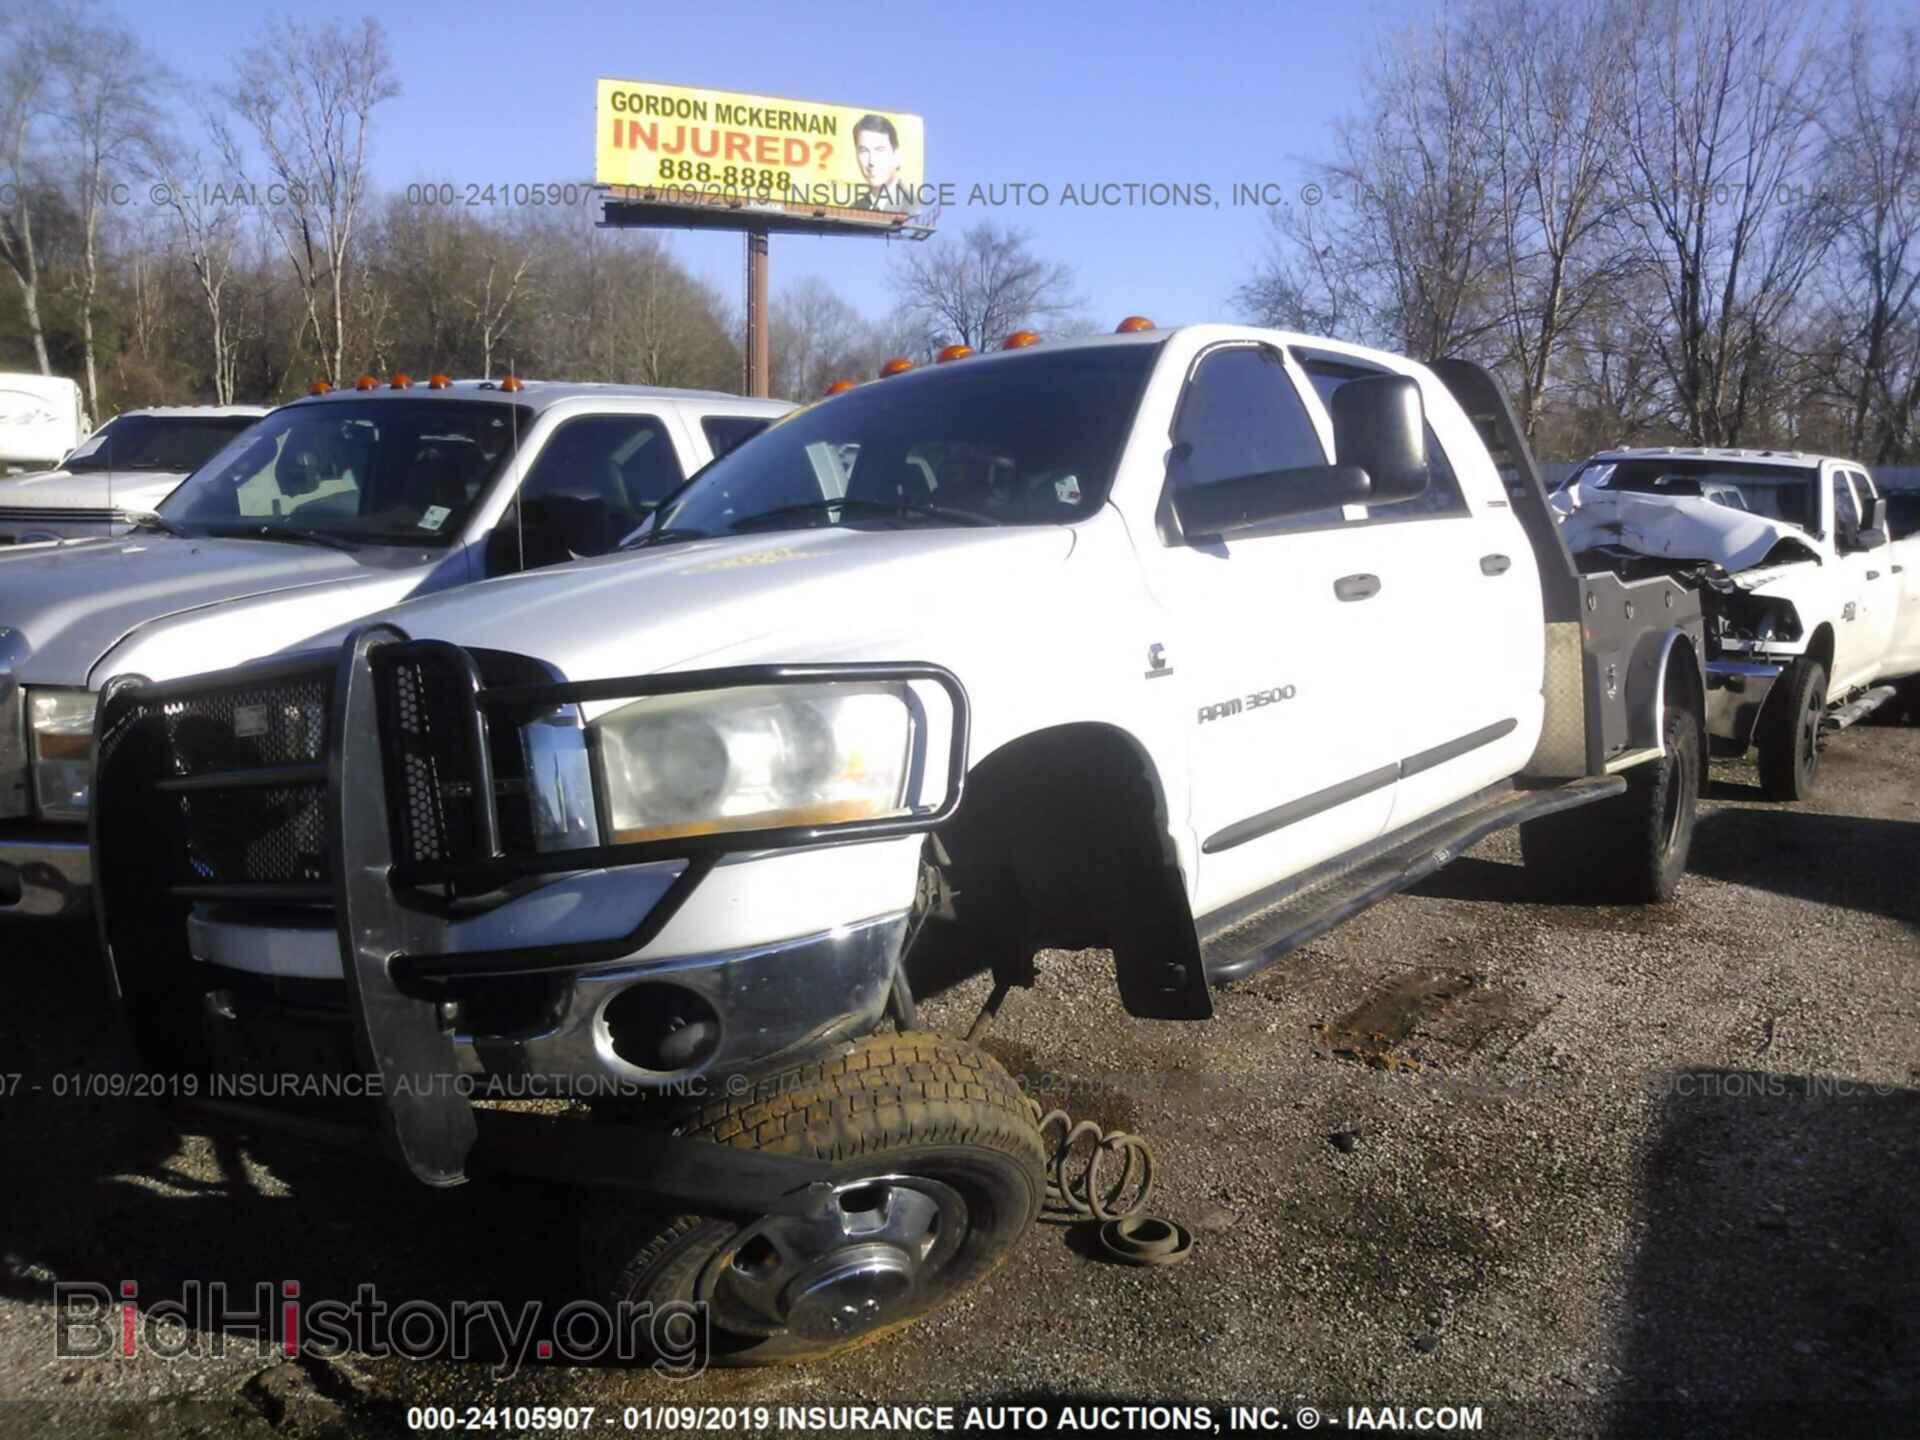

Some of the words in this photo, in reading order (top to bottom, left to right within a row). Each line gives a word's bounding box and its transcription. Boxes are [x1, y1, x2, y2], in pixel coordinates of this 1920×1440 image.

[611, 91, 708, 121] GORDON
[715, 103, 838, 136] MCKERNAN
[613, 119, 835, 171] INJURED?
[659, 158, 792, 192] 888-8888
[1245, 684, 1297, 711] 3500
